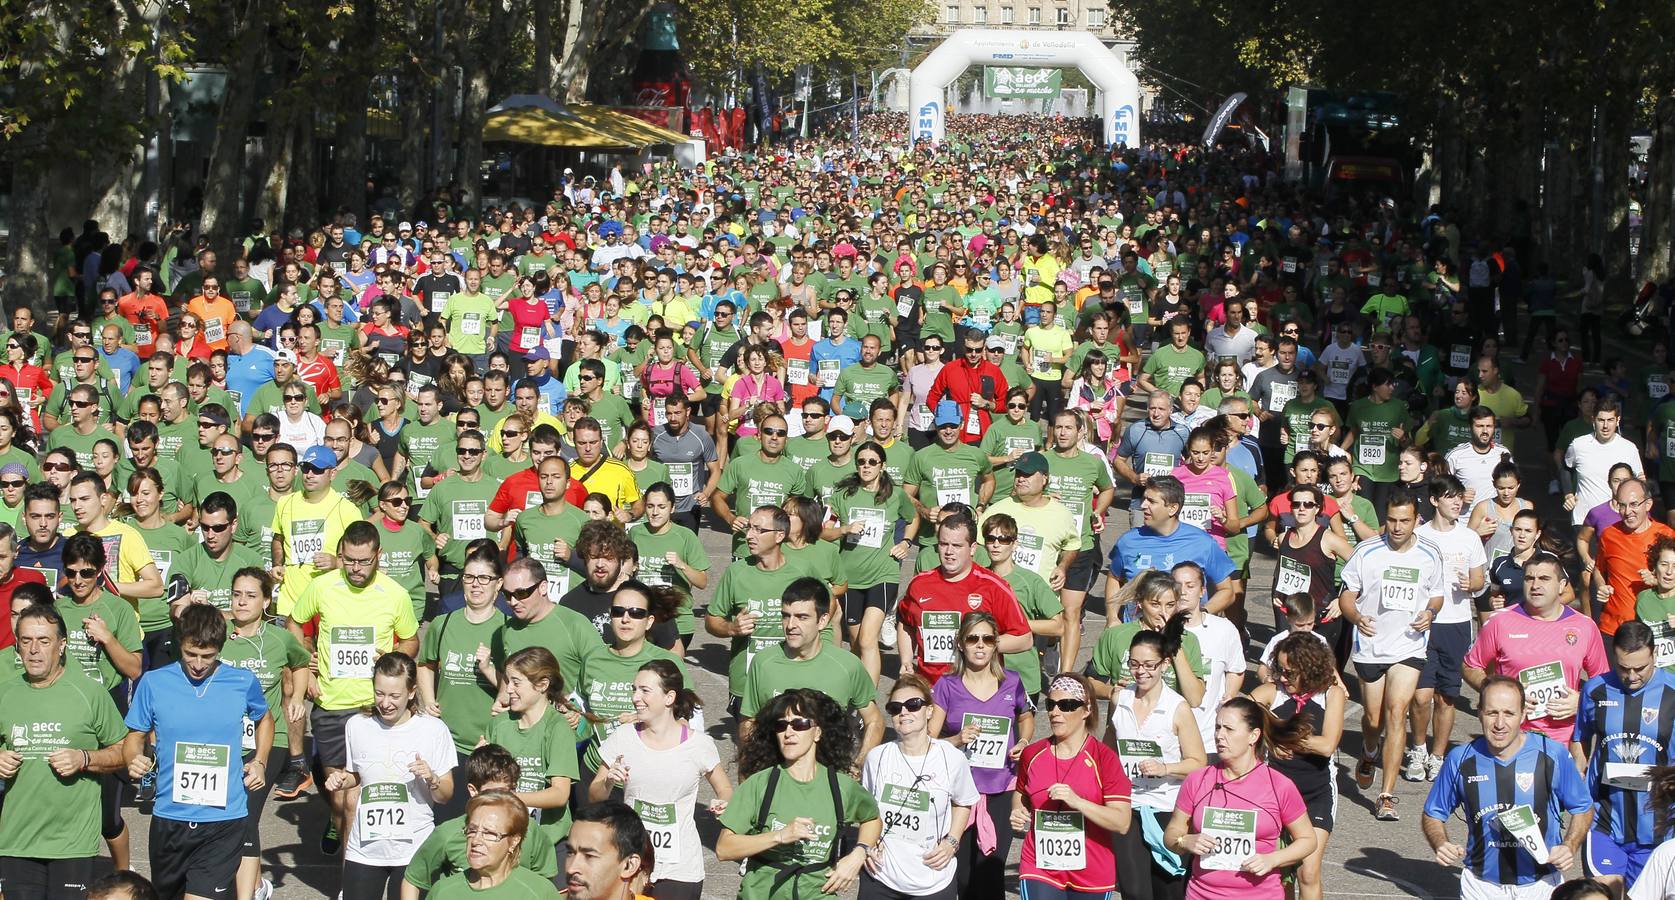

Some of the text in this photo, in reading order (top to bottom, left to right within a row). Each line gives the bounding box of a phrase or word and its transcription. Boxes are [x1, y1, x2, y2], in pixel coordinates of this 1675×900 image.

[920, 106, 932, 141] FMD
[1114, 110, 1128, 144] FMD
[206, 328, 222, 338] 11000
[76, 452, 92, 460] aecc
[1363, 448, 1381, 458] 8820
[945, 494, 962, 504] 787
[1182, 508, 1208, 521] 14697
[458, 519, 482, 531] 7168
[292, 538, 322, 552] 10639
[1284, 572, 1306, 589] 9737
[1383, 584, 1414, 601] 10713
[240, 659, 267, 668] aecc
[337, 650, 368, 666] 9566
[32, 722, 62, 732] aecc
[42, 736, 71, 744] marcha
[1636, 734, 1664, 752] ABONOS
[516, 756, 542, 766] aecc
[180, 772, 217, 791] 5711
[1468, 774, 1489, 784] joma
[367, 808, 404, 826] 5712
[884, 810, 920, 831] 8243
[1225, 812, 1243, 820] aecc
[1040, 838, 1081, 856] 10329
